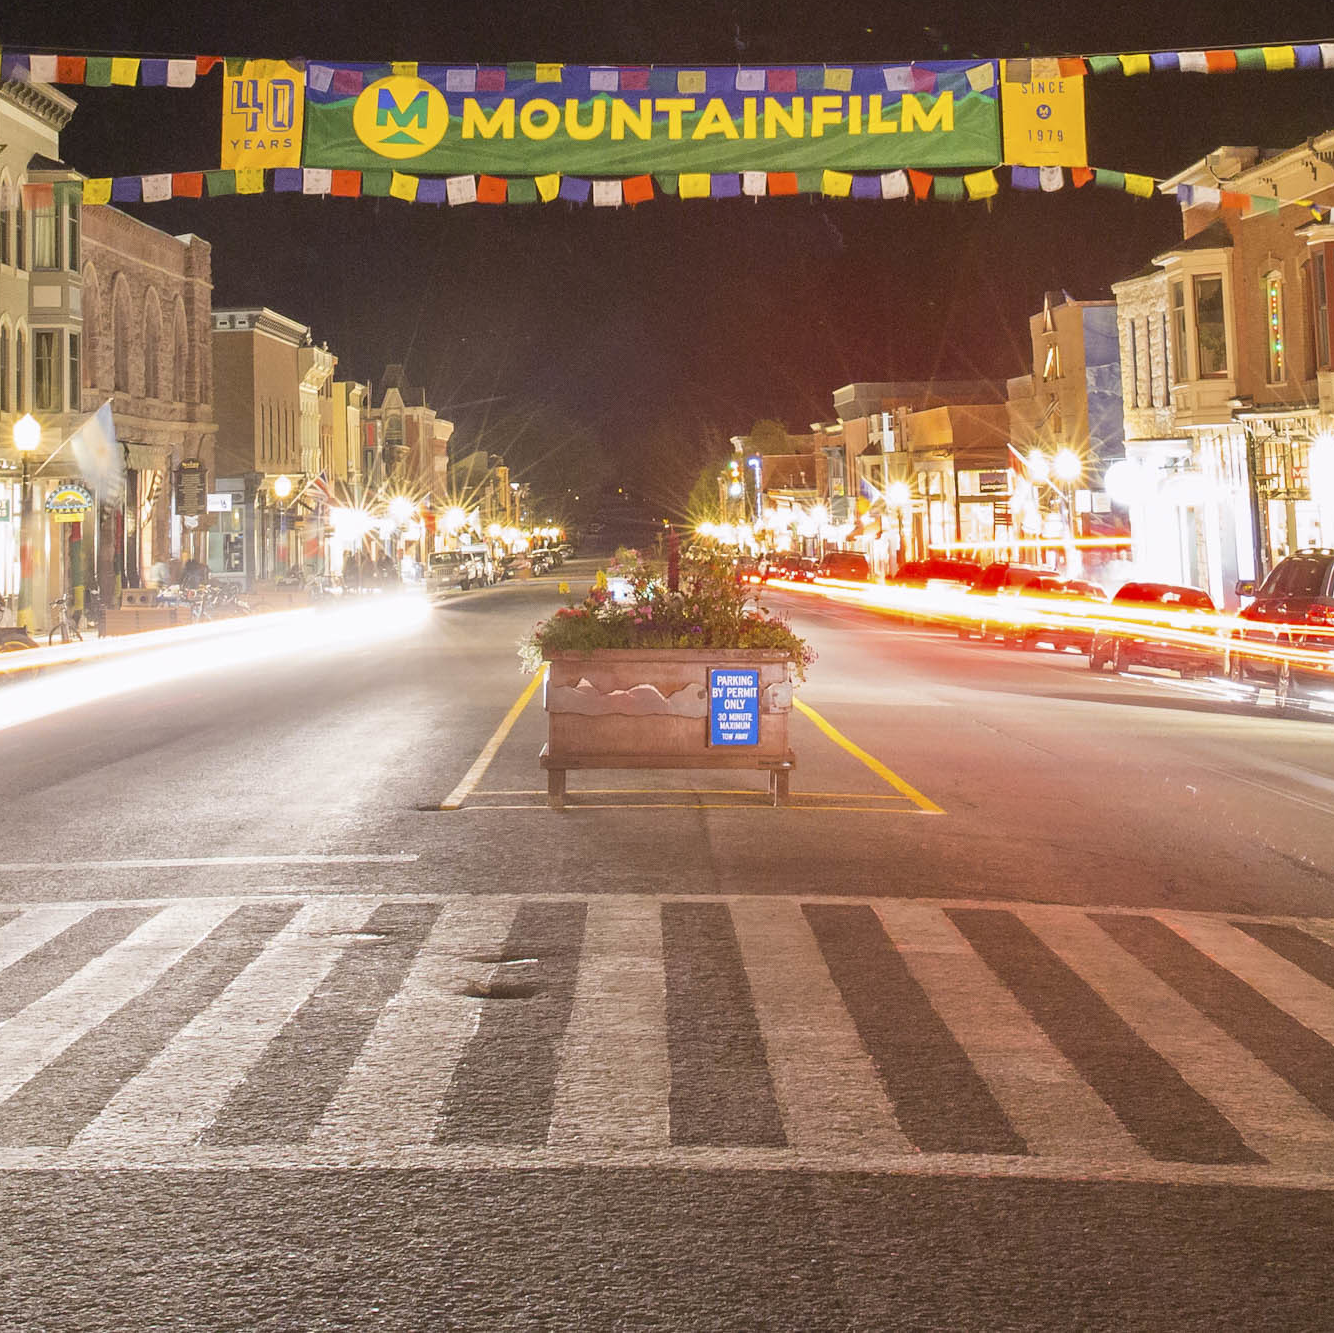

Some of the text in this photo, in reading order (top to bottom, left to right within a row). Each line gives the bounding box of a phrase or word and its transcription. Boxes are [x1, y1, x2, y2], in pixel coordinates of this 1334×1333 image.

[1021, 81, 1065, 94] SINCE
[231, 79, 295, 132] 40
[462, 91, 954, 140] MOUNTAINFILM
[1028, 129, 1064, 142] 1979
[230, 138, 292, 150] YEARS
[716, 675, 753, 686] PARKING
[712, 687, 758, 698] BY PERMIT
[724, 699, 746, 710] ONLY
[717, 713, 753, 721] 30 MINUTE
[719, 721, 751, 730] MAXIMUM
